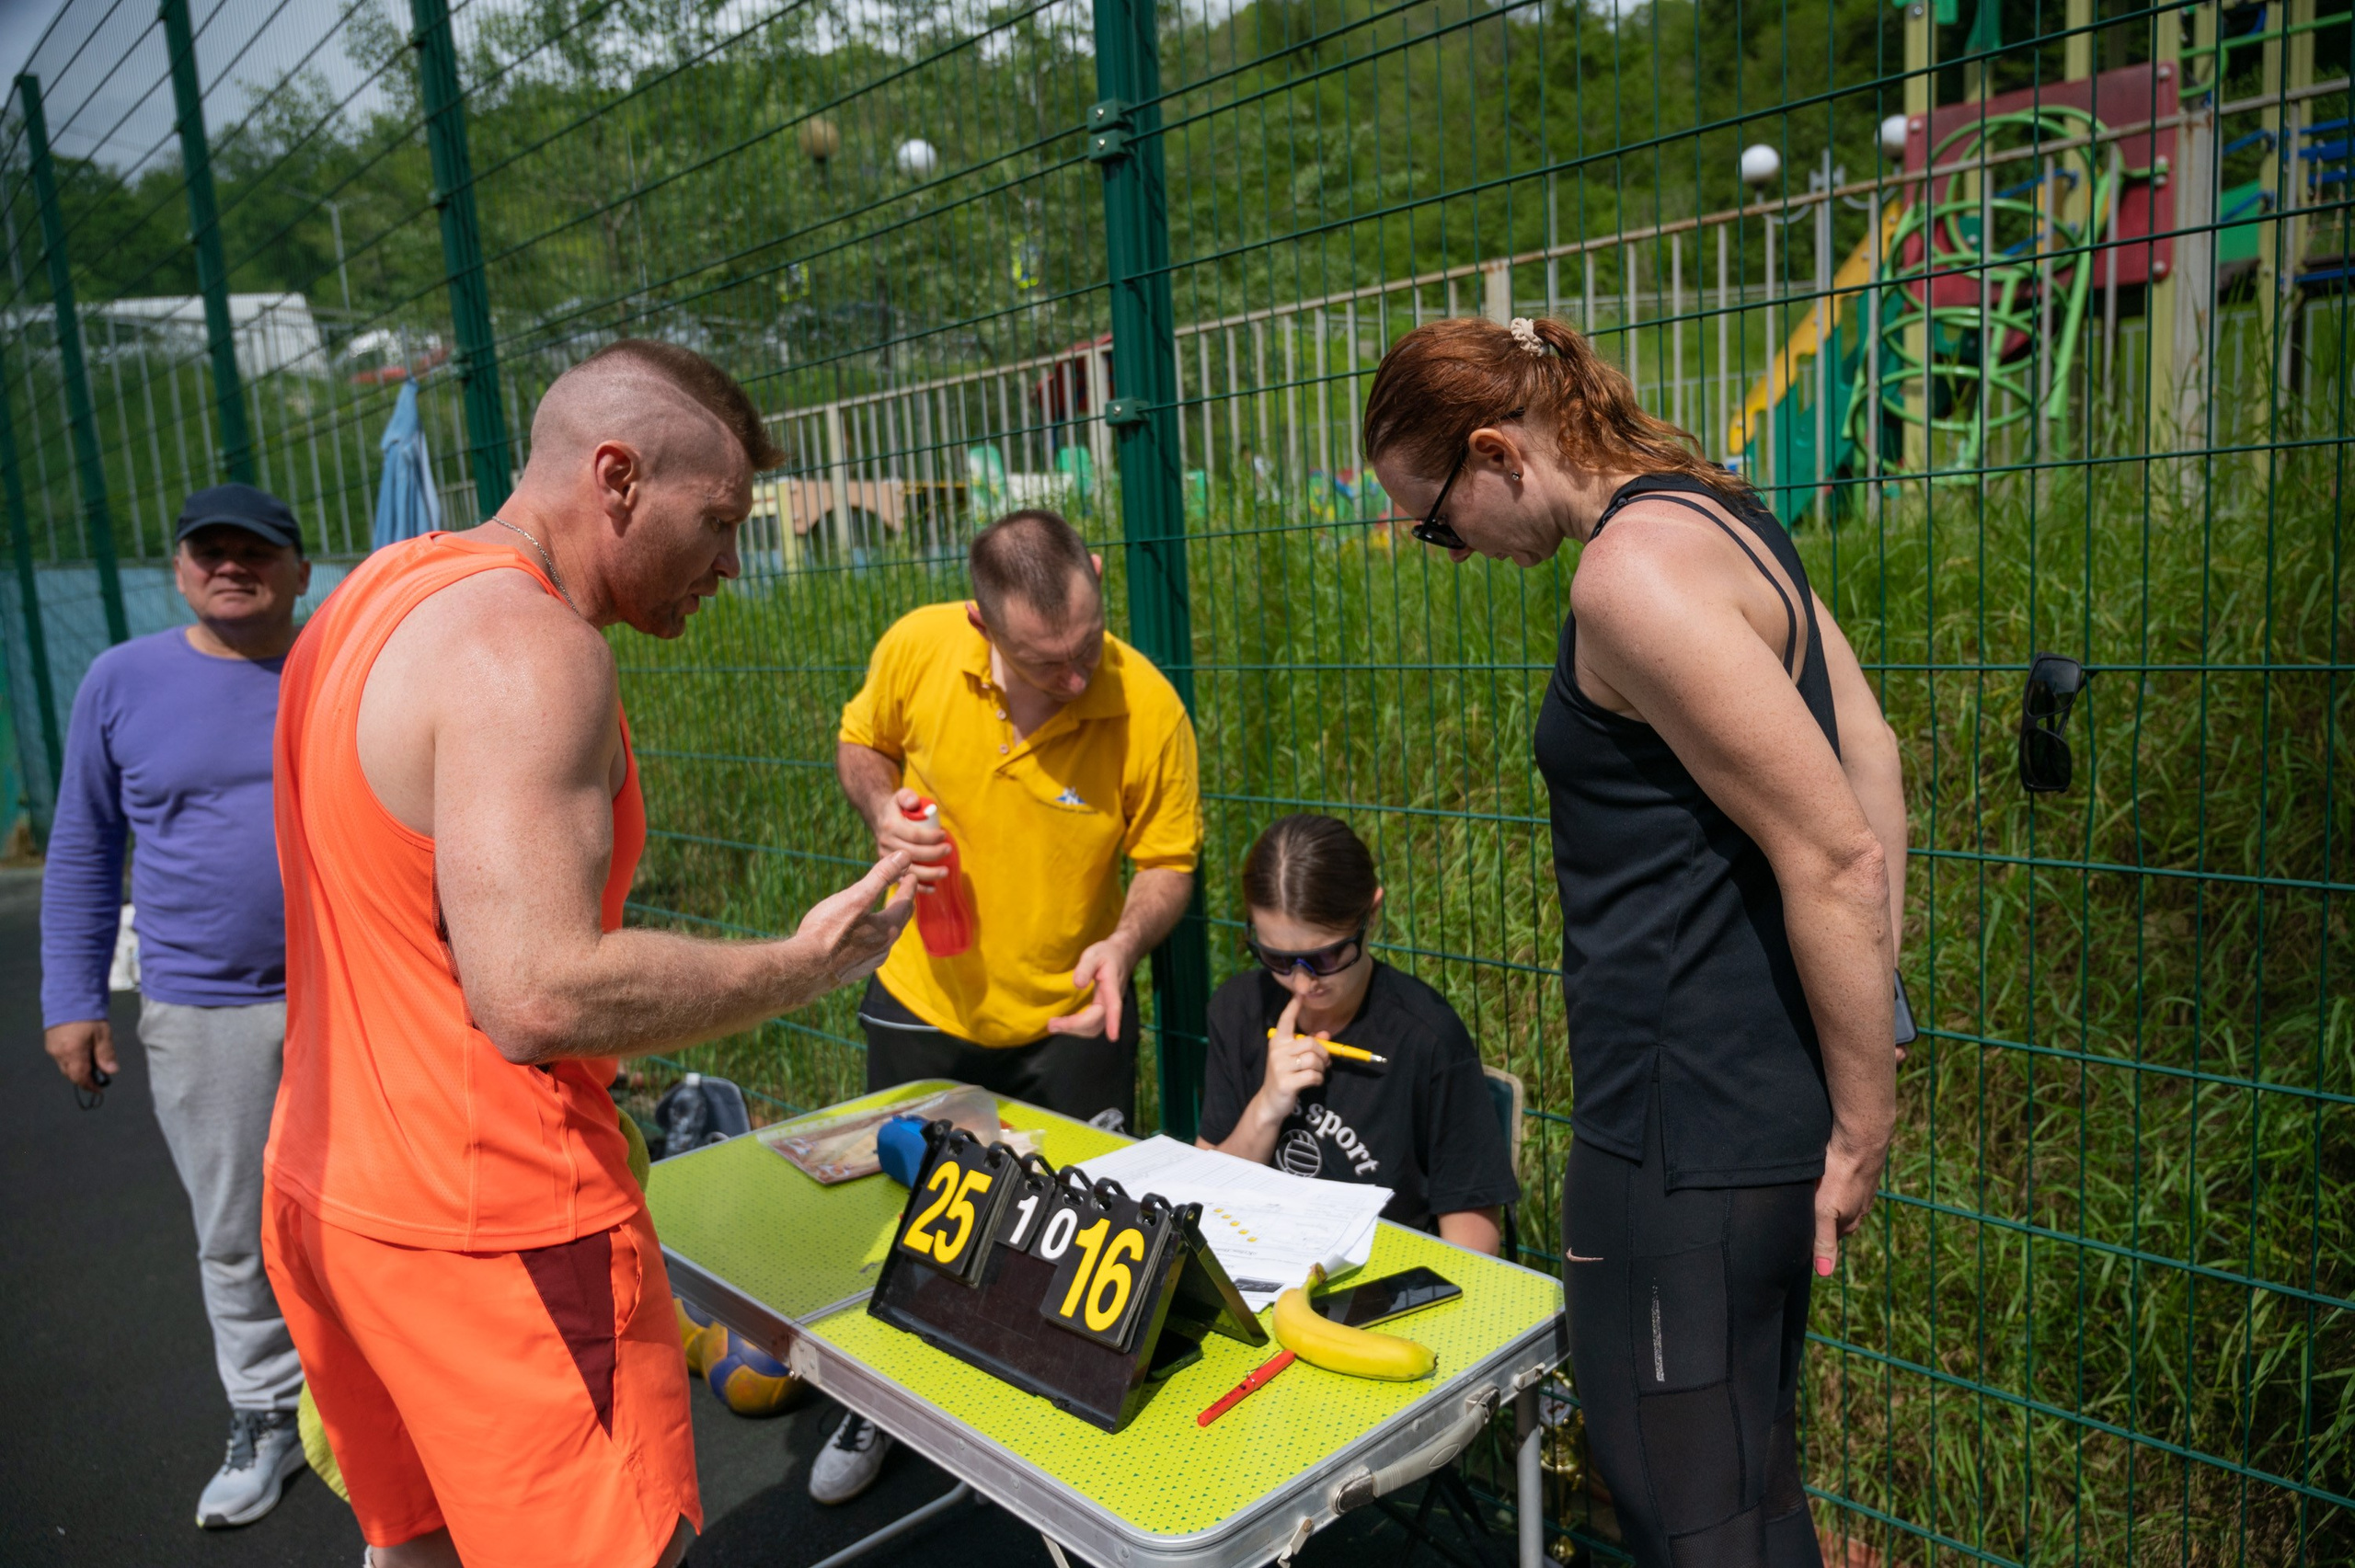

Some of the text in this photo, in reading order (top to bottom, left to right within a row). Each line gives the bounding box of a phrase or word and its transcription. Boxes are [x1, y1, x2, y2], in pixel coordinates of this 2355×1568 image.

[1304, 1103, 1380, 1177] sport
[902, 1161, 994, 1265] 25
[1059, 1218, 1145, 1332] 16
